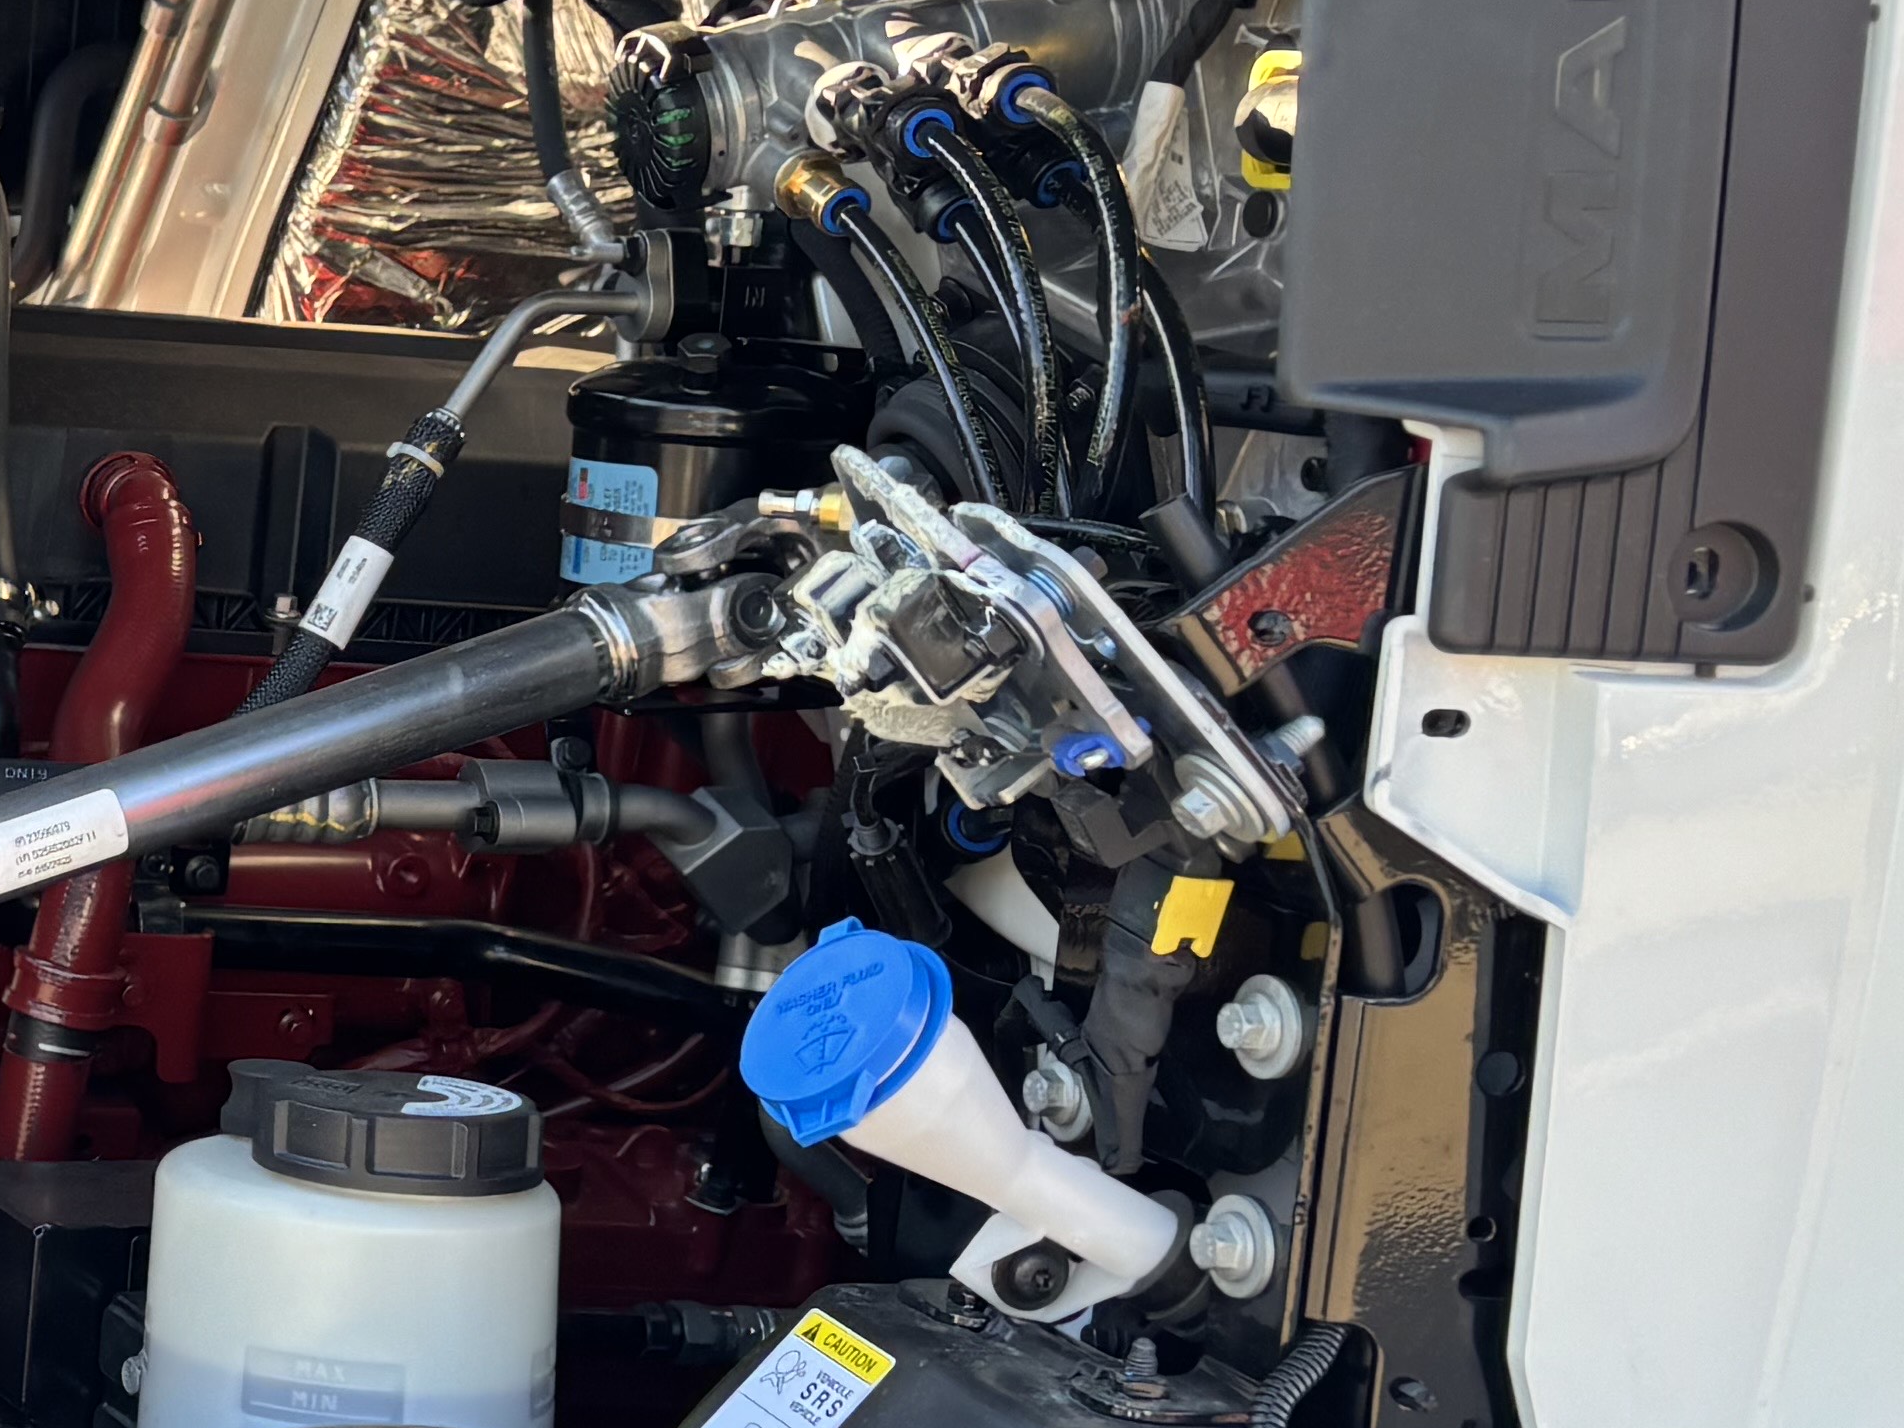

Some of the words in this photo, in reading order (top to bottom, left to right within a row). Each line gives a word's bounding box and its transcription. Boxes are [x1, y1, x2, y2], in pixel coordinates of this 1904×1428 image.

[776, 982, 836, 1013] WASHER
[842, 962, 883, 989] FLUID
[807, 991, 843, 1015] ONLY
[822, 1333, 876, 1372] CAUTION
[294, 1361, 346, 1382] MAX
[291, 1390, 339, 1412] MIN
